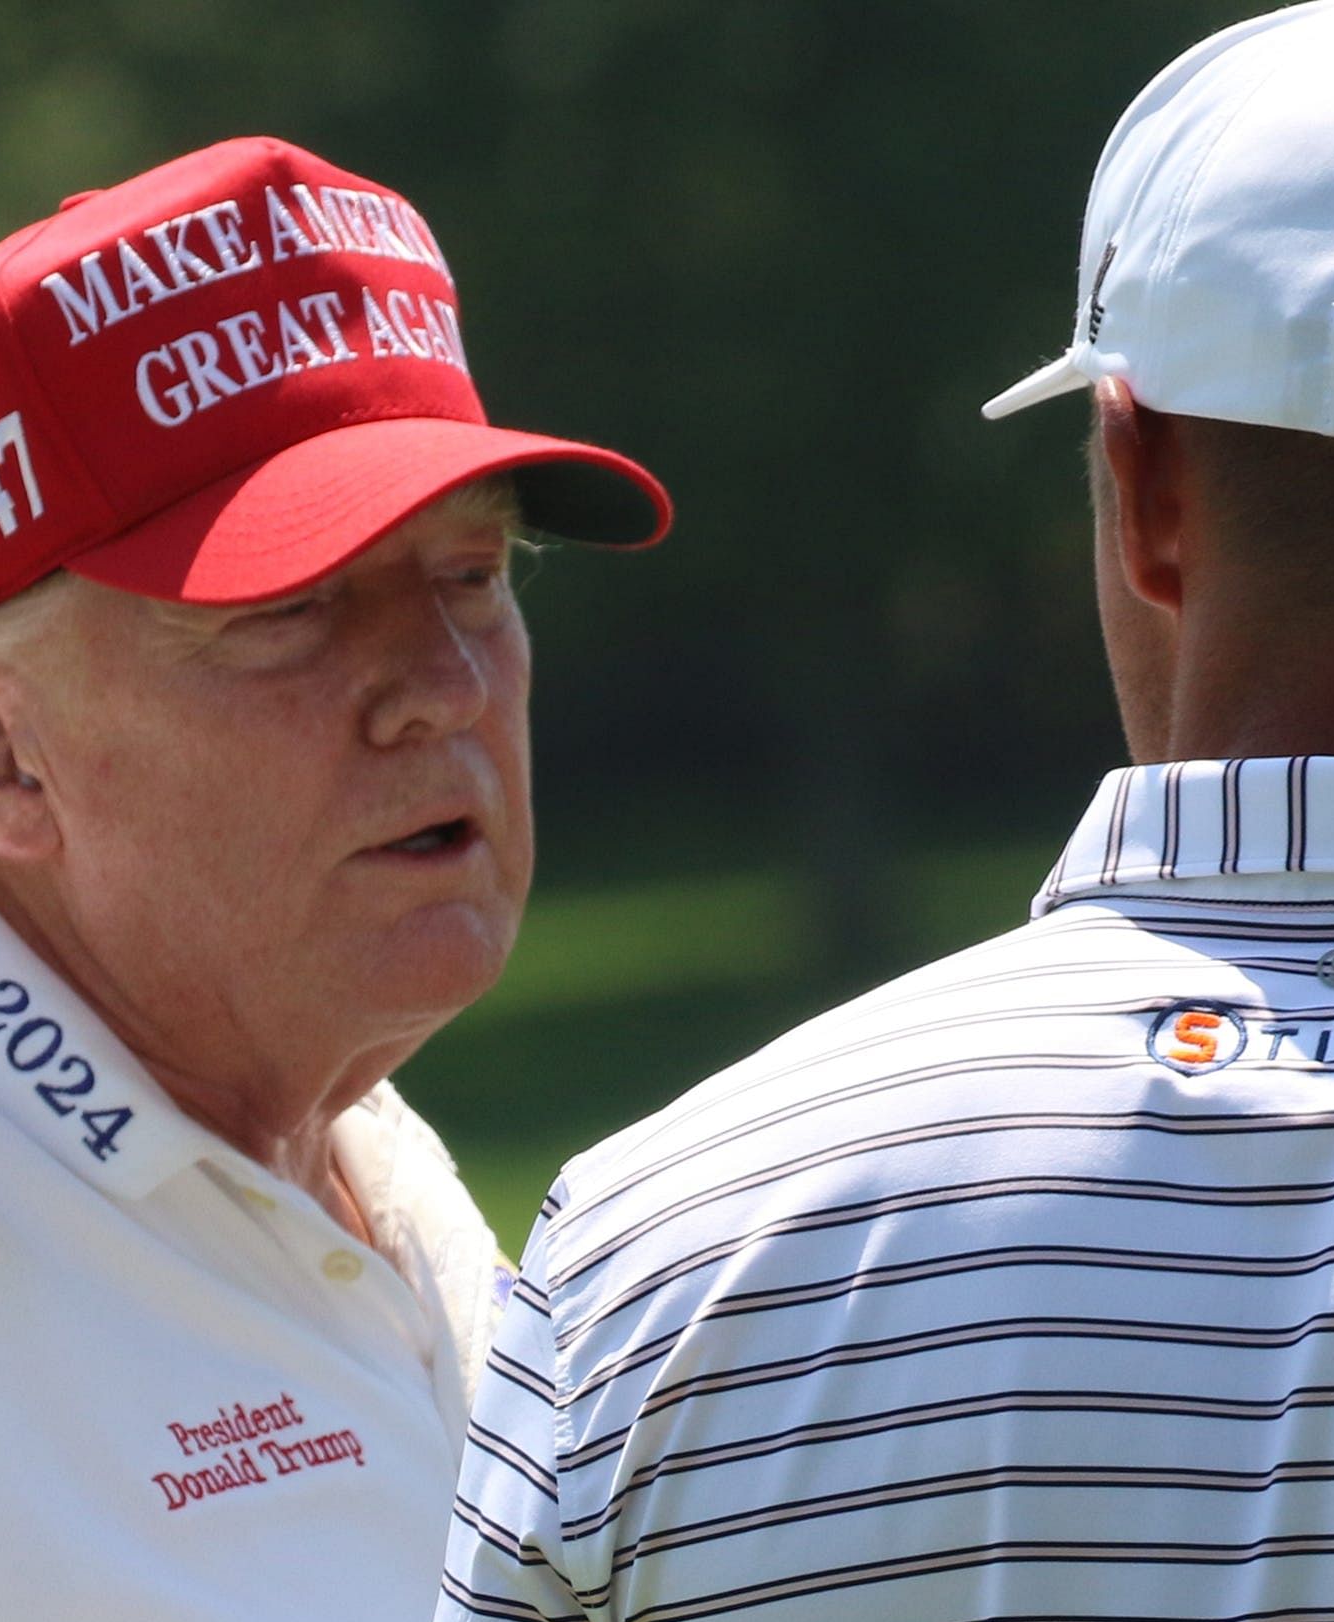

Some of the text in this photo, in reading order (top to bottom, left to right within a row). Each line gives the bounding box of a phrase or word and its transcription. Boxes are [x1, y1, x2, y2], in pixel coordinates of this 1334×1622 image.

[40, 200, 264, 346] MAKE
[134, 285, 469, 428] GREAT AGAI
[151, 1429, 365, 1511] Donald Trump
[165, 1391, 305, 1457] President
